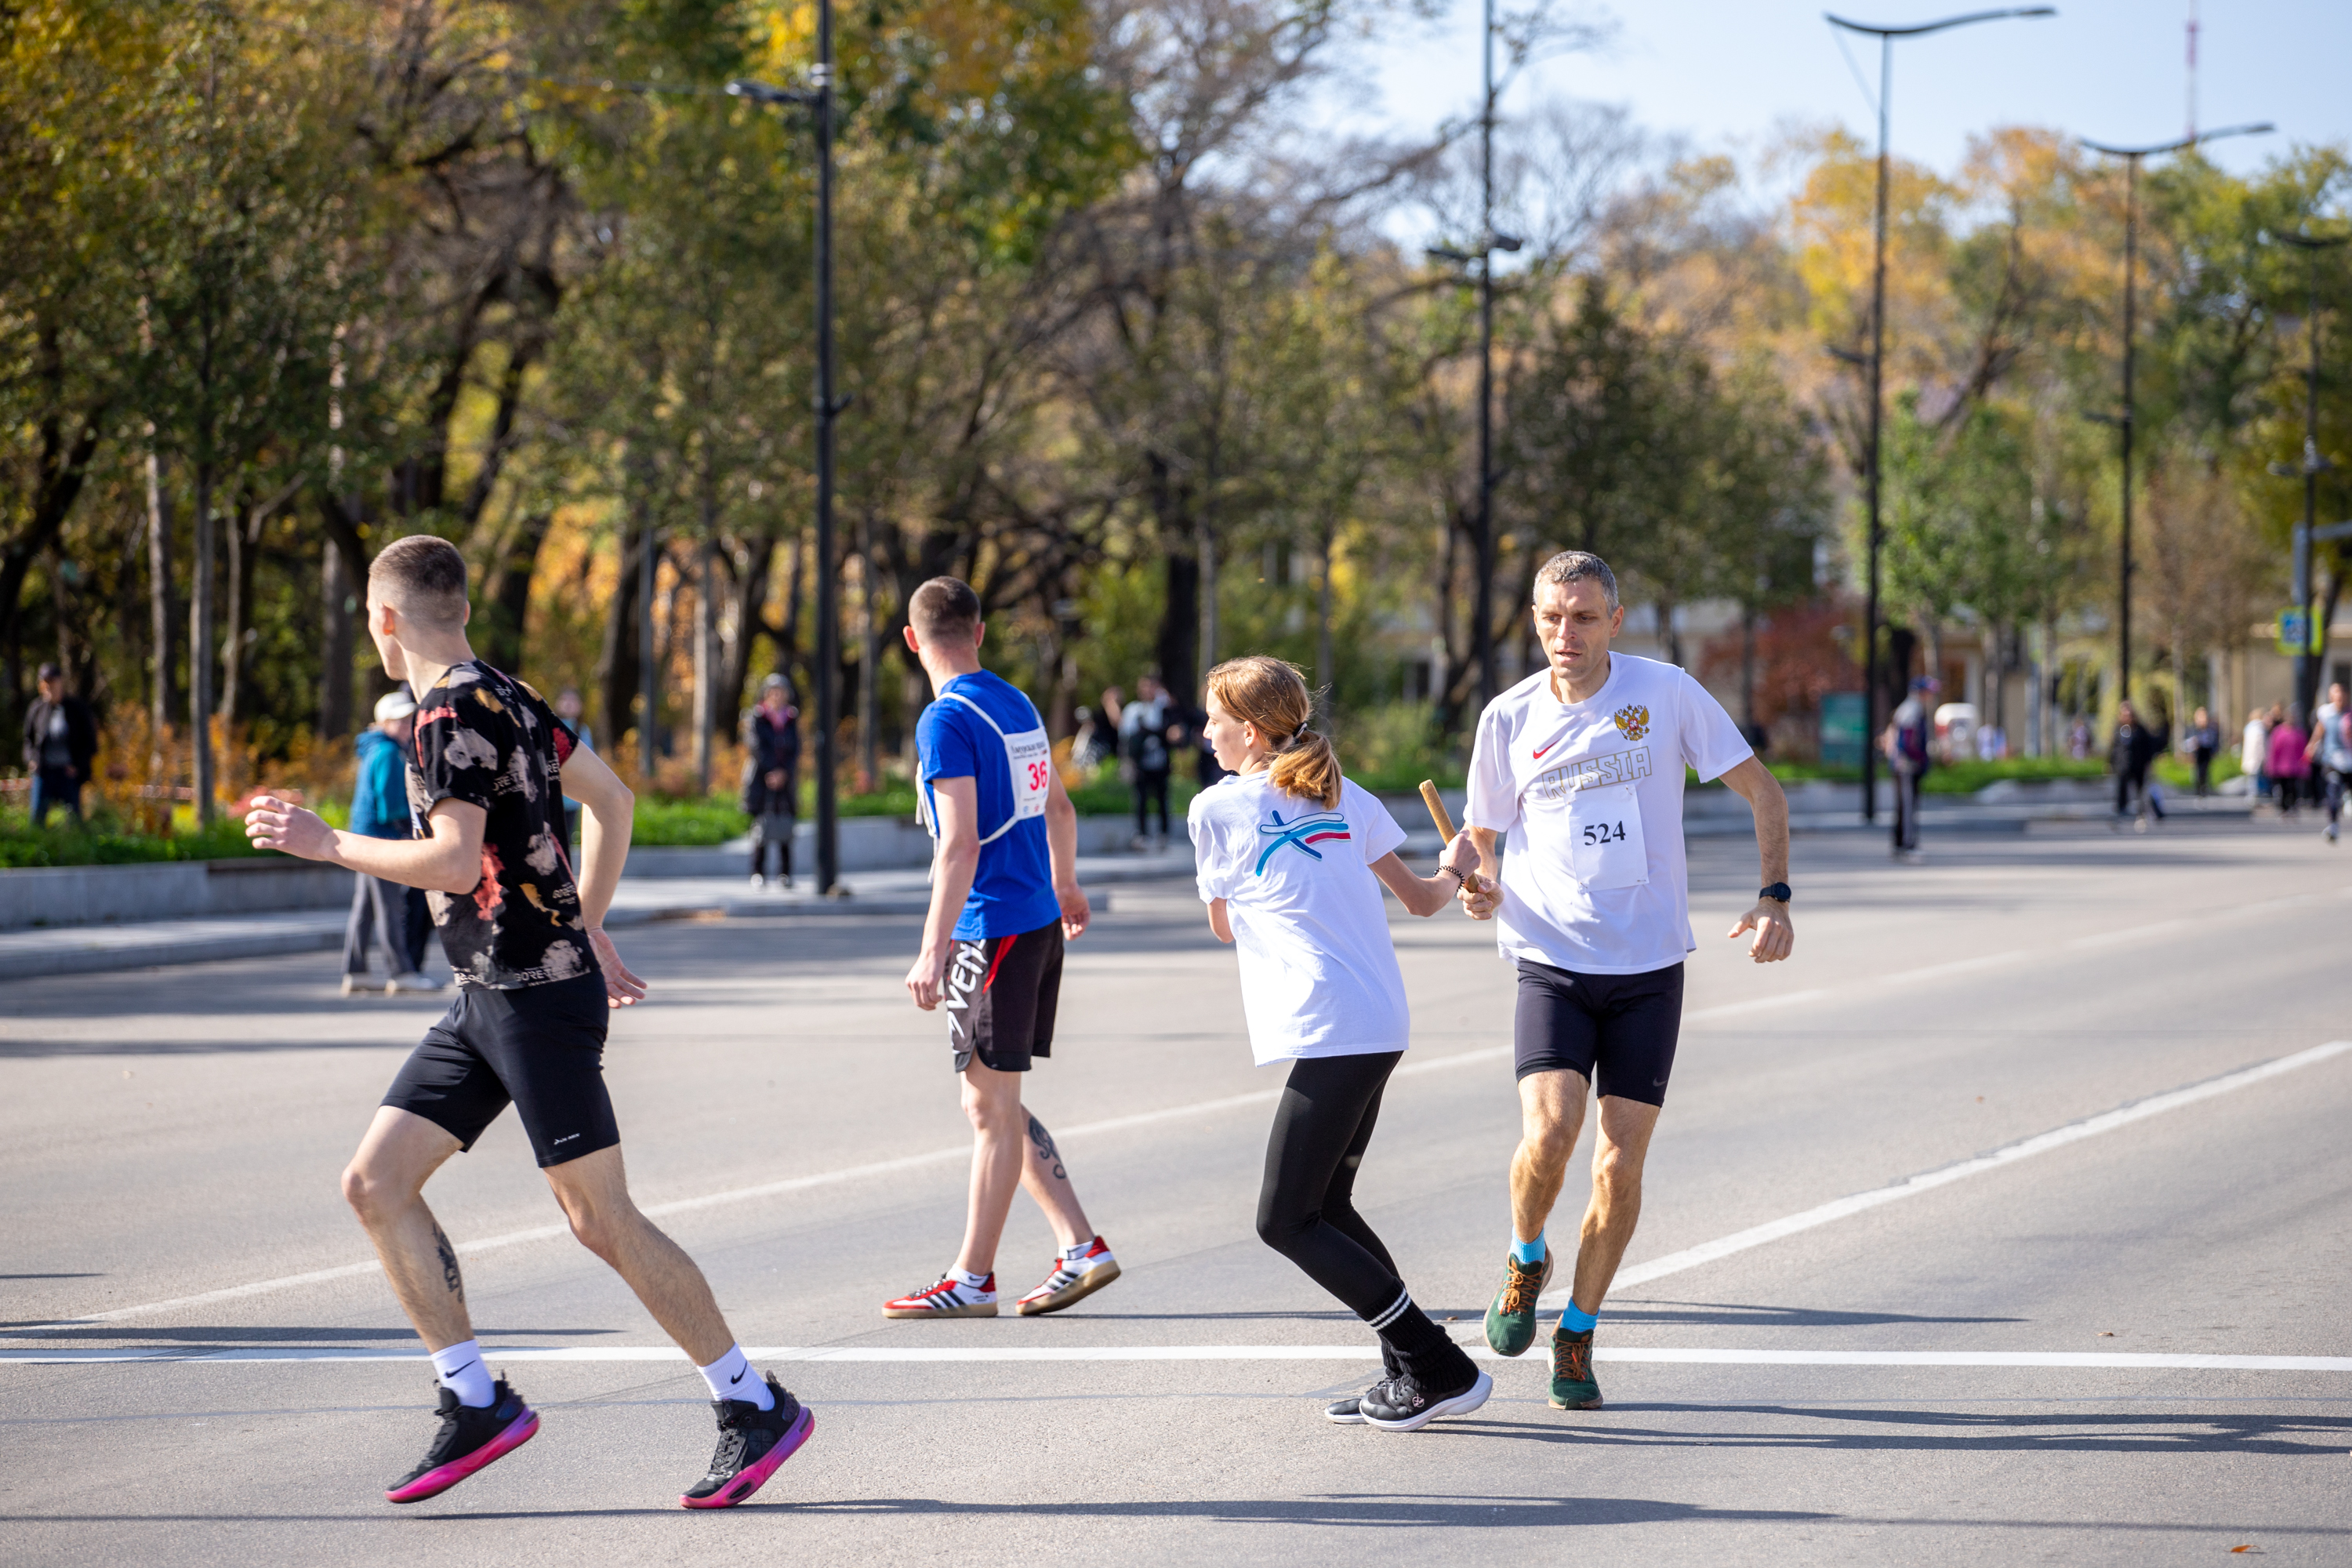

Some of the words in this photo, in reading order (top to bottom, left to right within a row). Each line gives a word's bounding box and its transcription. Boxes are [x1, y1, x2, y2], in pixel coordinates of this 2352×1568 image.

[1028, 760, 1048, 791] 36
[1541, 746, 1652, 800] RUSSIA
[1583, 820, 1626, 846] 524
